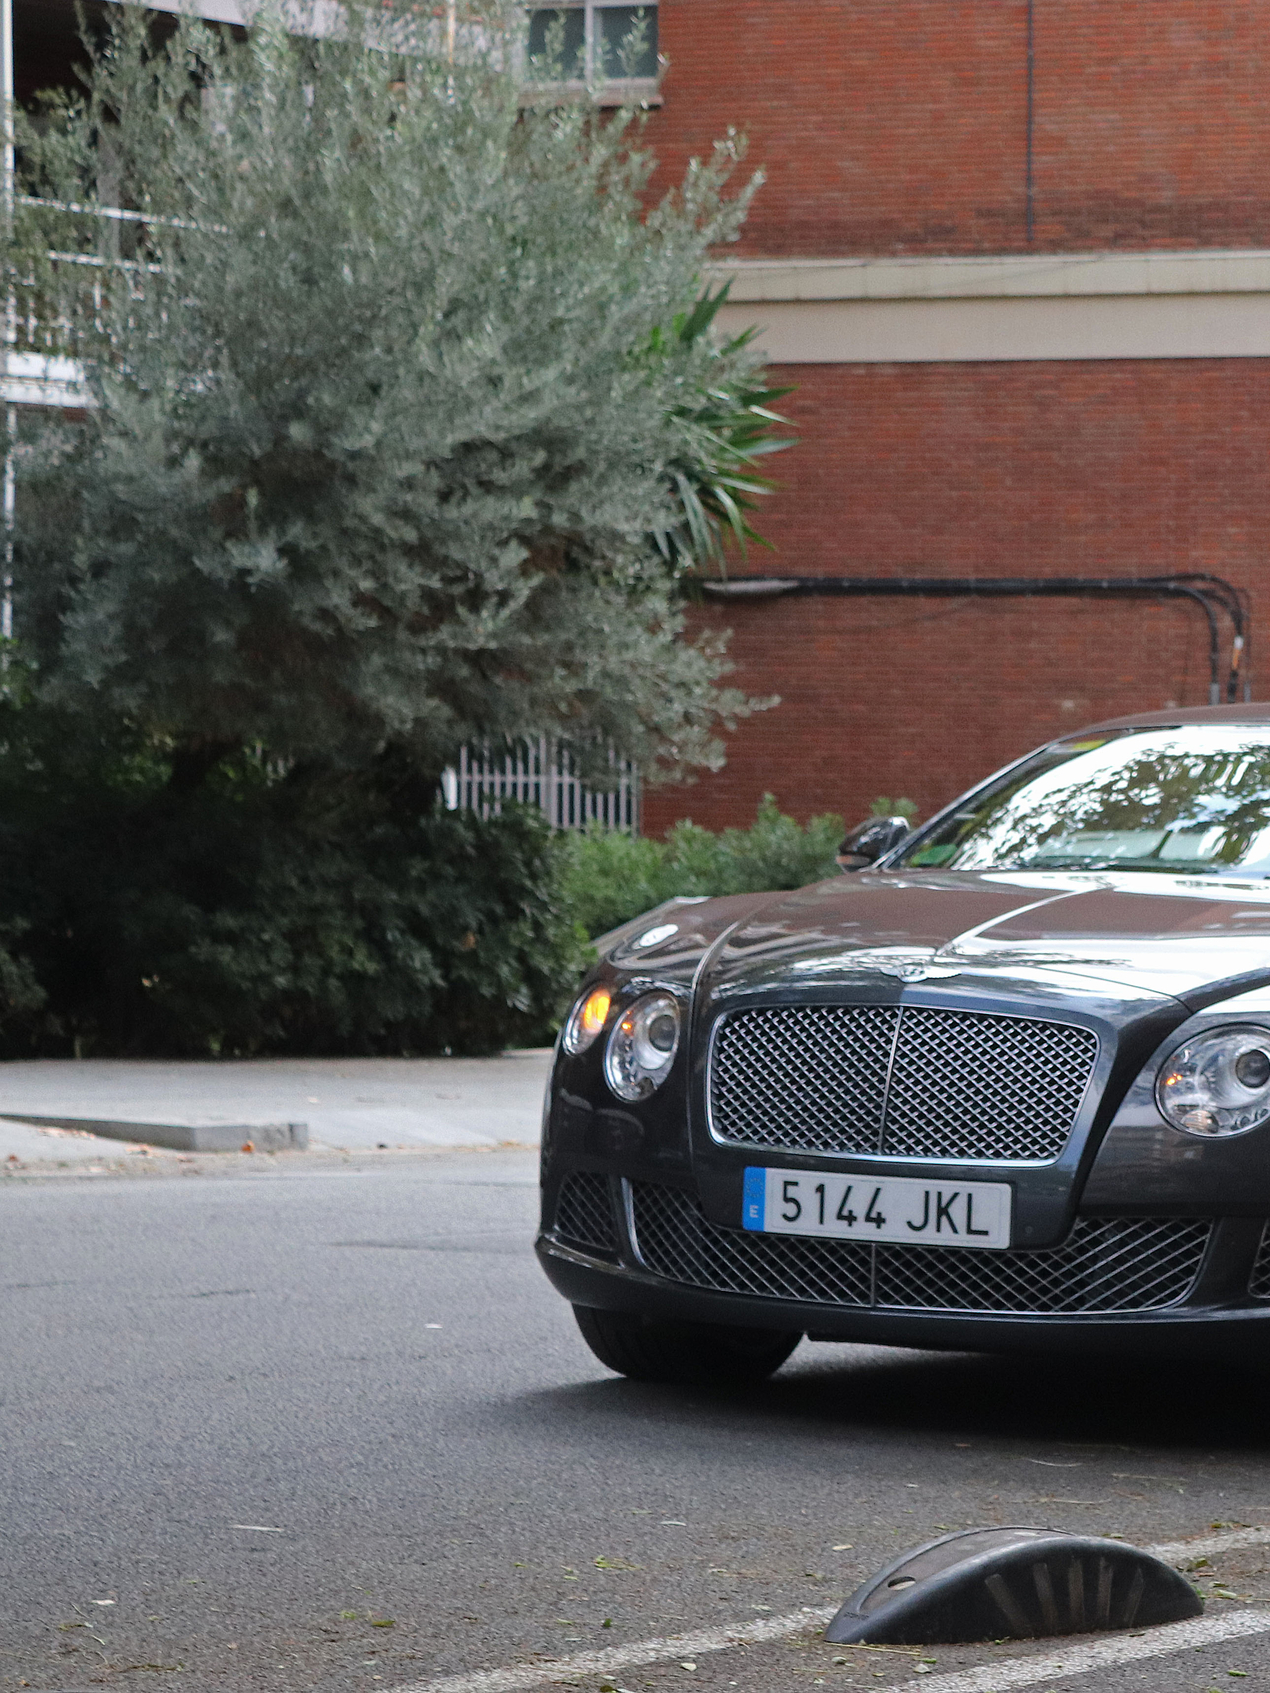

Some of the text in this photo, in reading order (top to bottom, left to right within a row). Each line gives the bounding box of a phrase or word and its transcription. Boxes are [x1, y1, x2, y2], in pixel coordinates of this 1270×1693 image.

[750, 1205, 759, 1218] E
[782, 1181, 989, 1236] 5144 JKL
